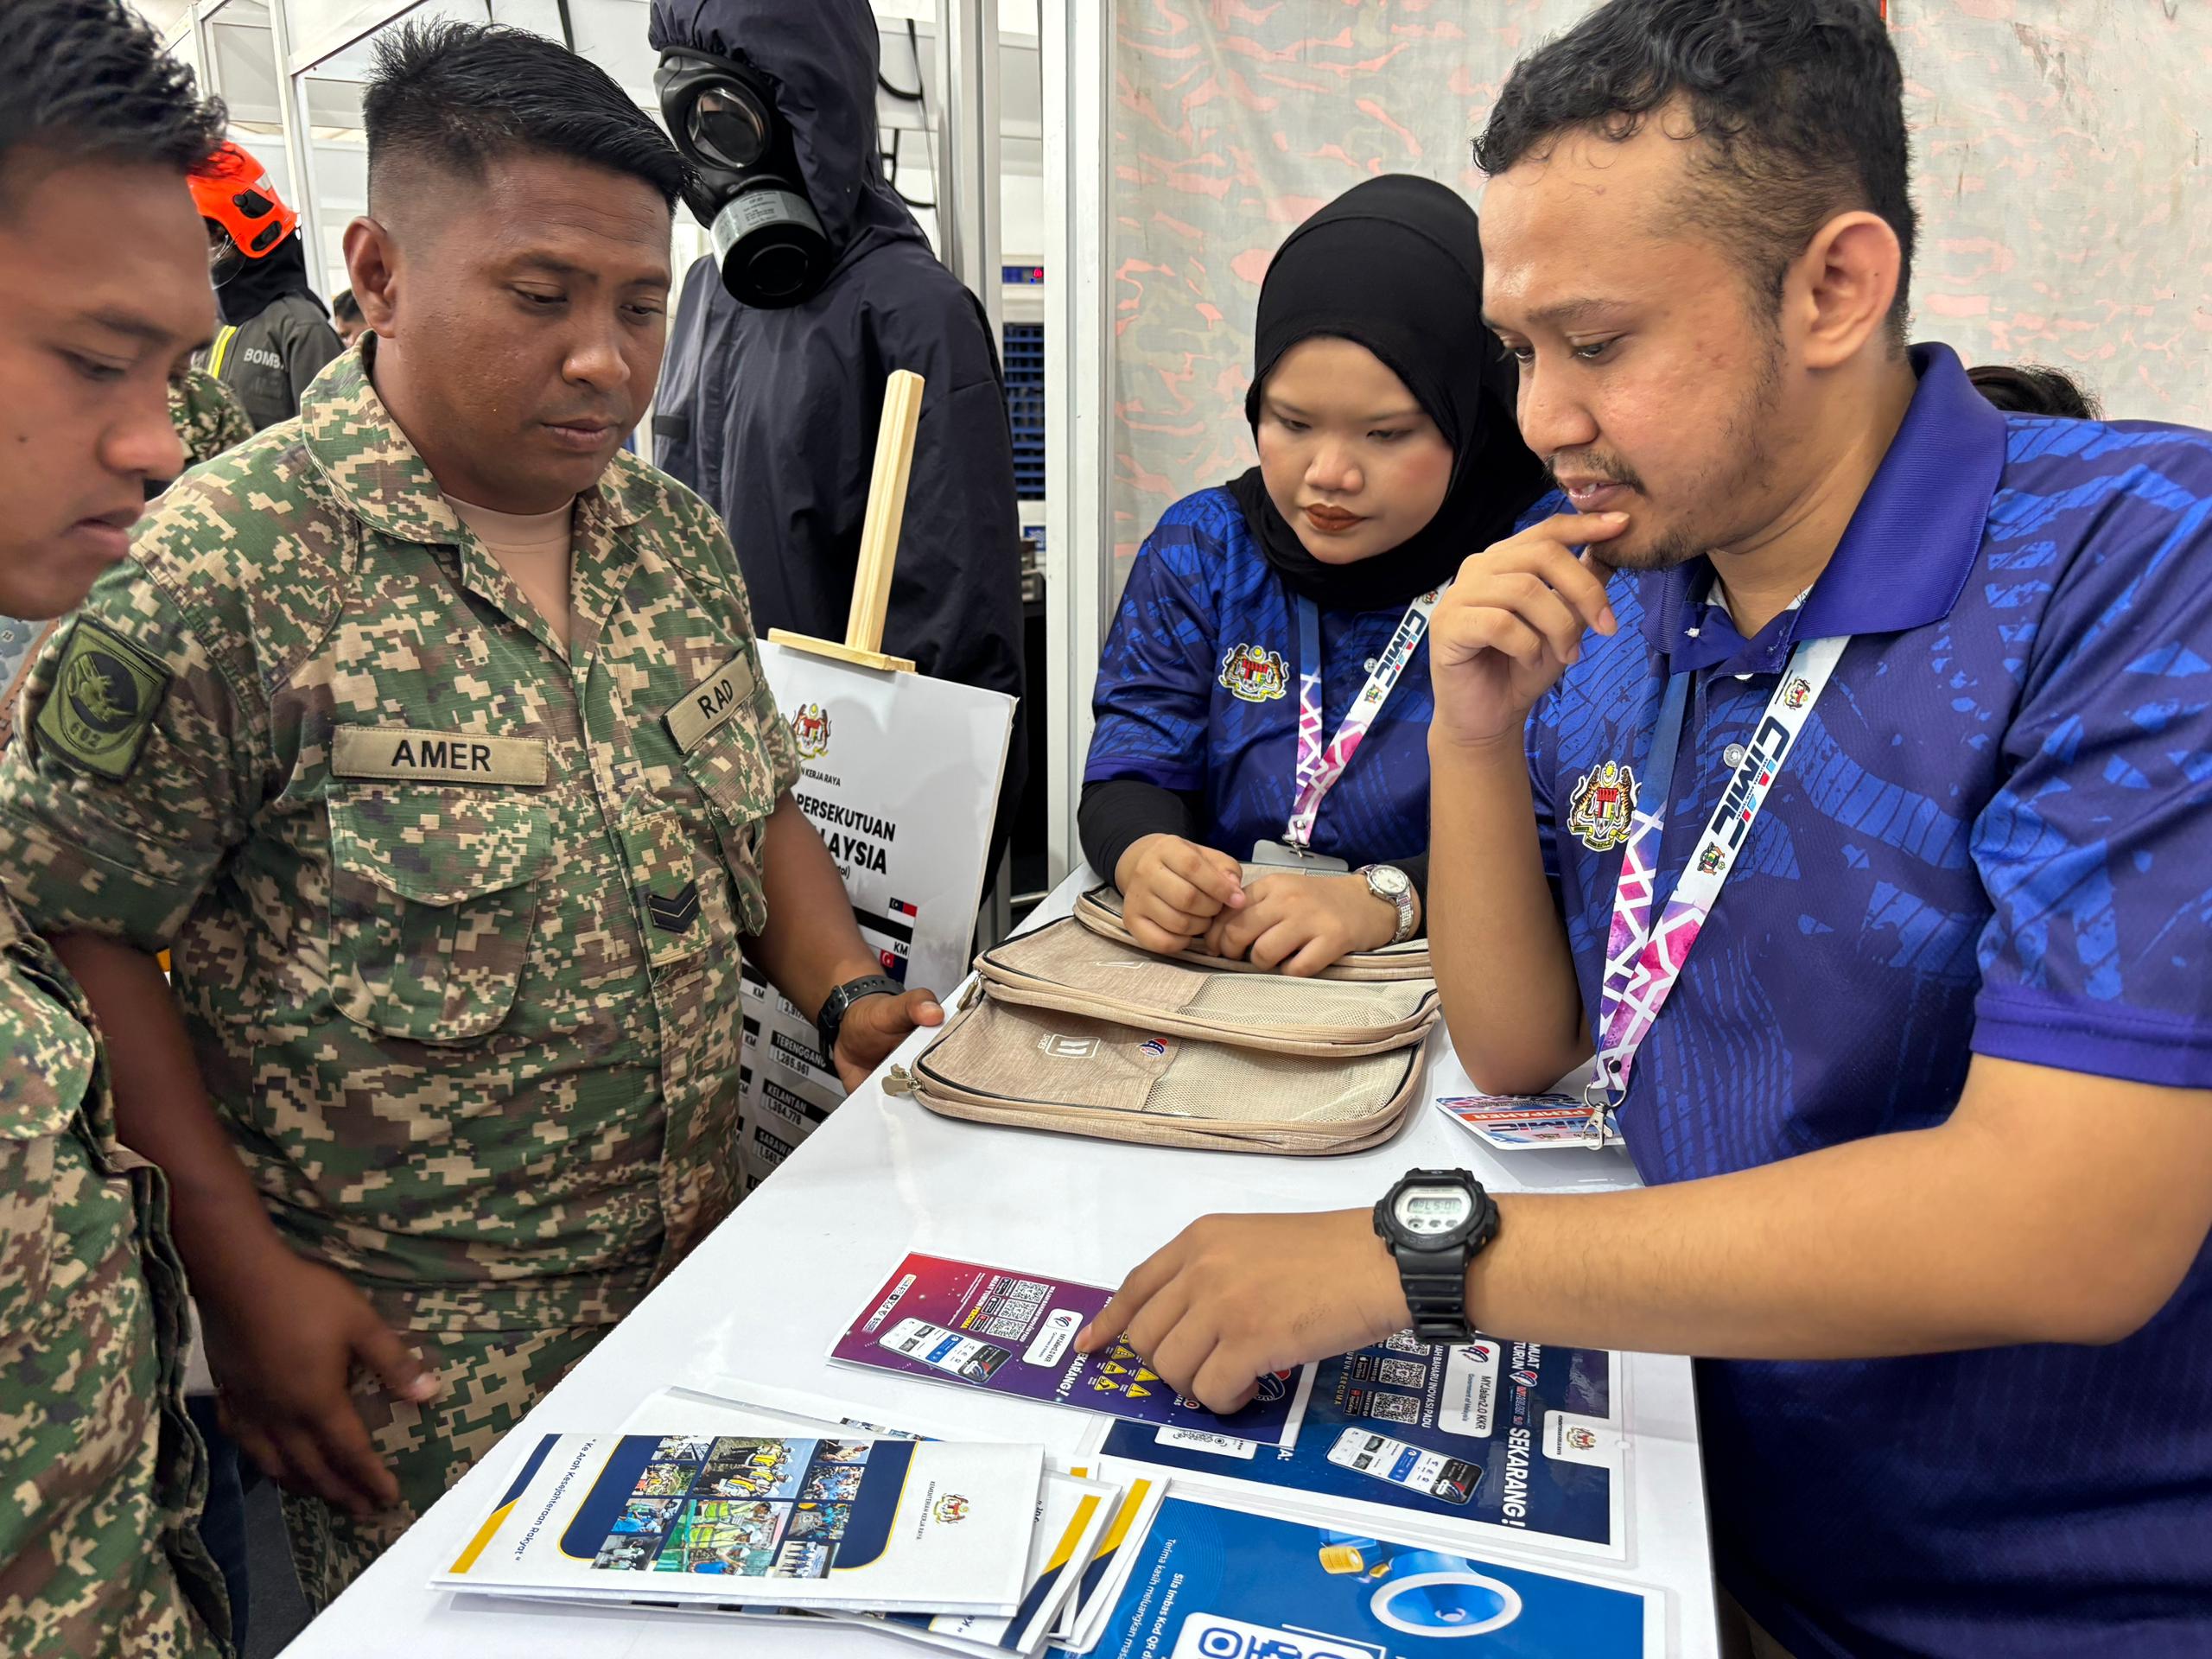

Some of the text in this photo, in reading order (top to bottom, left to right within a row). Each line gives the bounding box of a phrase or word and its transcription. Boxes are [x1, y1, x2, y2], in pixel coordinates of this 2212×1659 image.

[244, 348, 284, 370] BOMB
[697, 678, 734, 720] RAD
[391, 740, 492, 772] AMER
[805, 768, 823, 781] KERJA
[823, 773, 841, 787] RAYA
[1711, 715, 1790, 850] CIMIC
[797, 793, 896, 842] PERSEKUTUAN
[820, 829, 887, 874] AYSIA
[893, 942, 908, 957] KM
[767, 1083, 807, 1113] KELANTAN
[1344, 1351, 1355, 1370] URUN
[1512, 1342, 1526, 1370] TURUN
[1527, 1343, 1541, 1369] MUAT
[1421, 1408, 1434, 1429] PADU
[1475, 1414, 1487, 1431] KKR
[582, 1442, 594, 1452] Ke
[570, 1452, 587, 1471] Arah
[534, 1471, 575, 1526] Kesejahteraan
[515, 1527, 540, 1554] Rakyat
[1158, 1539, 1177, 1564] Terima
[1149, 1564, 1166, 1586] kasih
[1170, 1573, 1185, 1589] Sila
[1127, 1586, 1154, 1638] meluangkan
[1159, 1589, 1179, 1616] Imbas
[1152, 1616, 1167, 1636] Kod
[1146, 1635, 1160, 1651] QR
